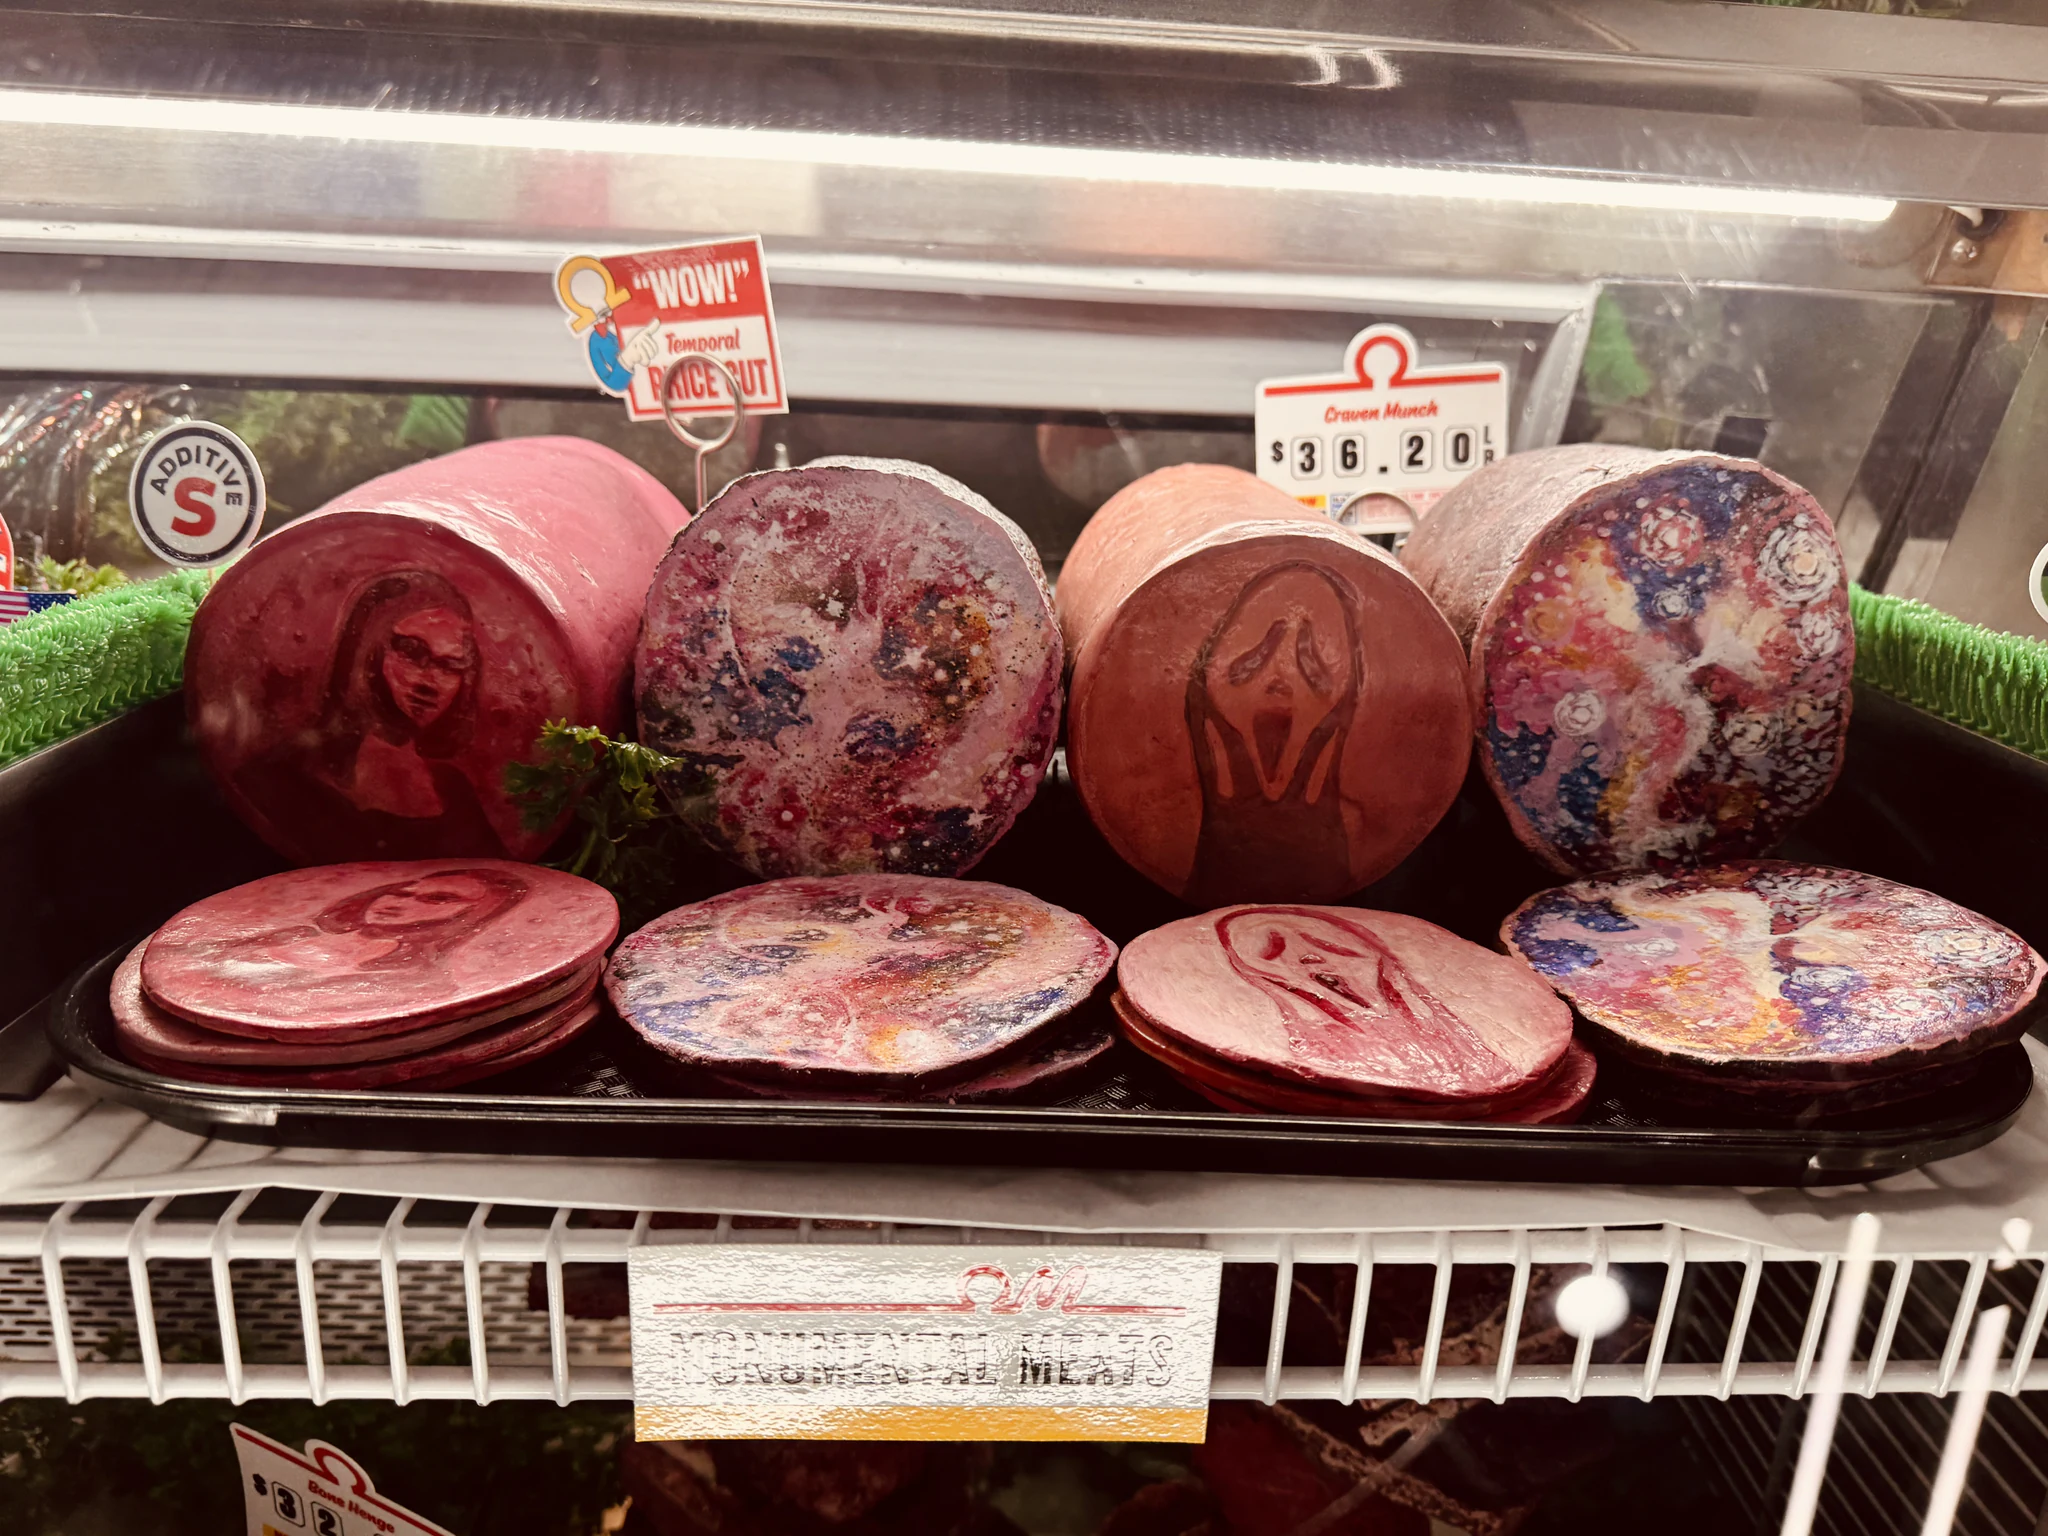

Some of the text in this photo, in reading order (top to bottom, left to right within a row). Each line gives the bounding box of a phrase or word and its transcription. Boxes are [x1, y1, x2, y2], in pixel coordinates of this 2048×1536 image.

[665, 328, 740, 354] Temporal
[648, 359, 720, 402] PRICE
[1324, 400, 1438, 423] Craven Munch
[150, 445, 242, 506] ADDITIVE
[171, 477, 216, 537] S
[1018, 1332, 1173, 1387] MEATS
[308, 1480, 395, 1534] Bone Henge
